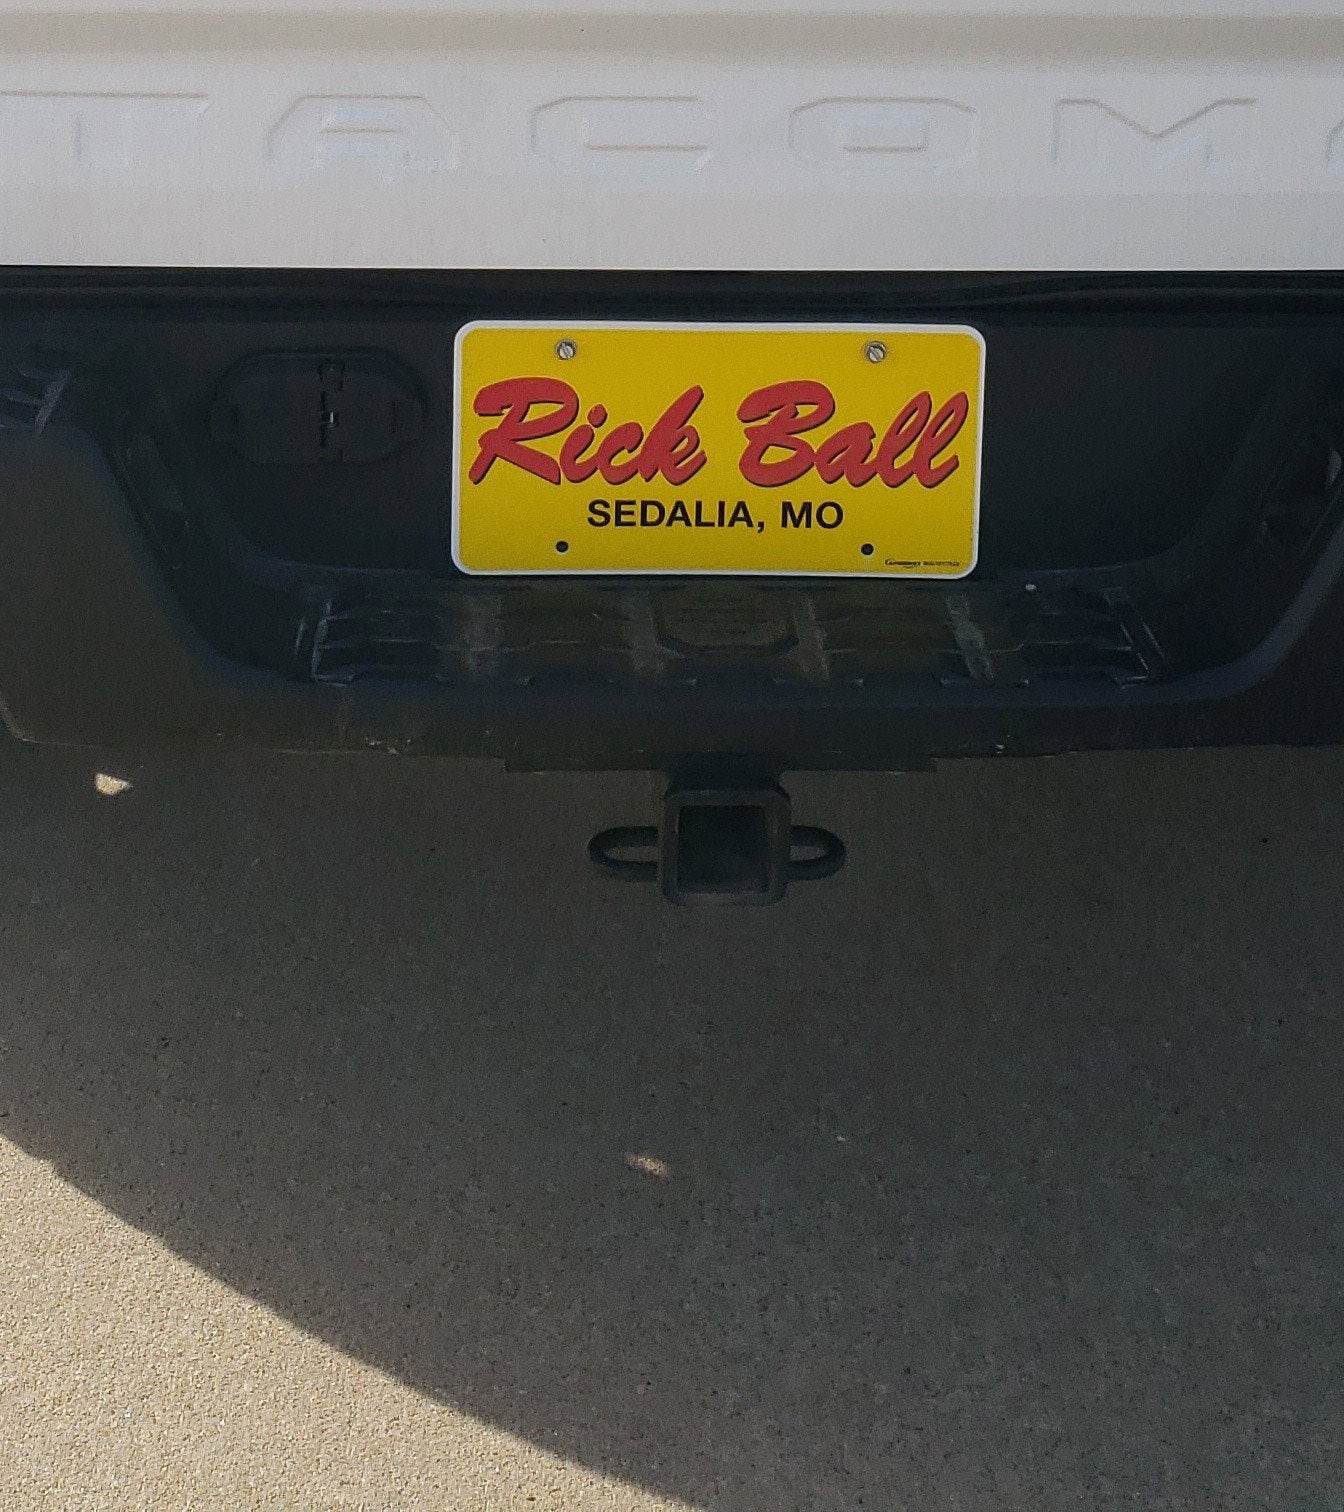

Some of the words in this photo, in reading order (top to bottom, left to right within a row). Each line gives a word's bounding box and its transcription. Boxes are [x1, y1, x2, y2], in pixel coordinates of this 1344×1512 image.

[468, 375, 707, 486] Rick
[736, 379, 970, 489] Ball
[587, 498, 766, 534] SEDALIA,
[781, 500, 845, 530] MO
